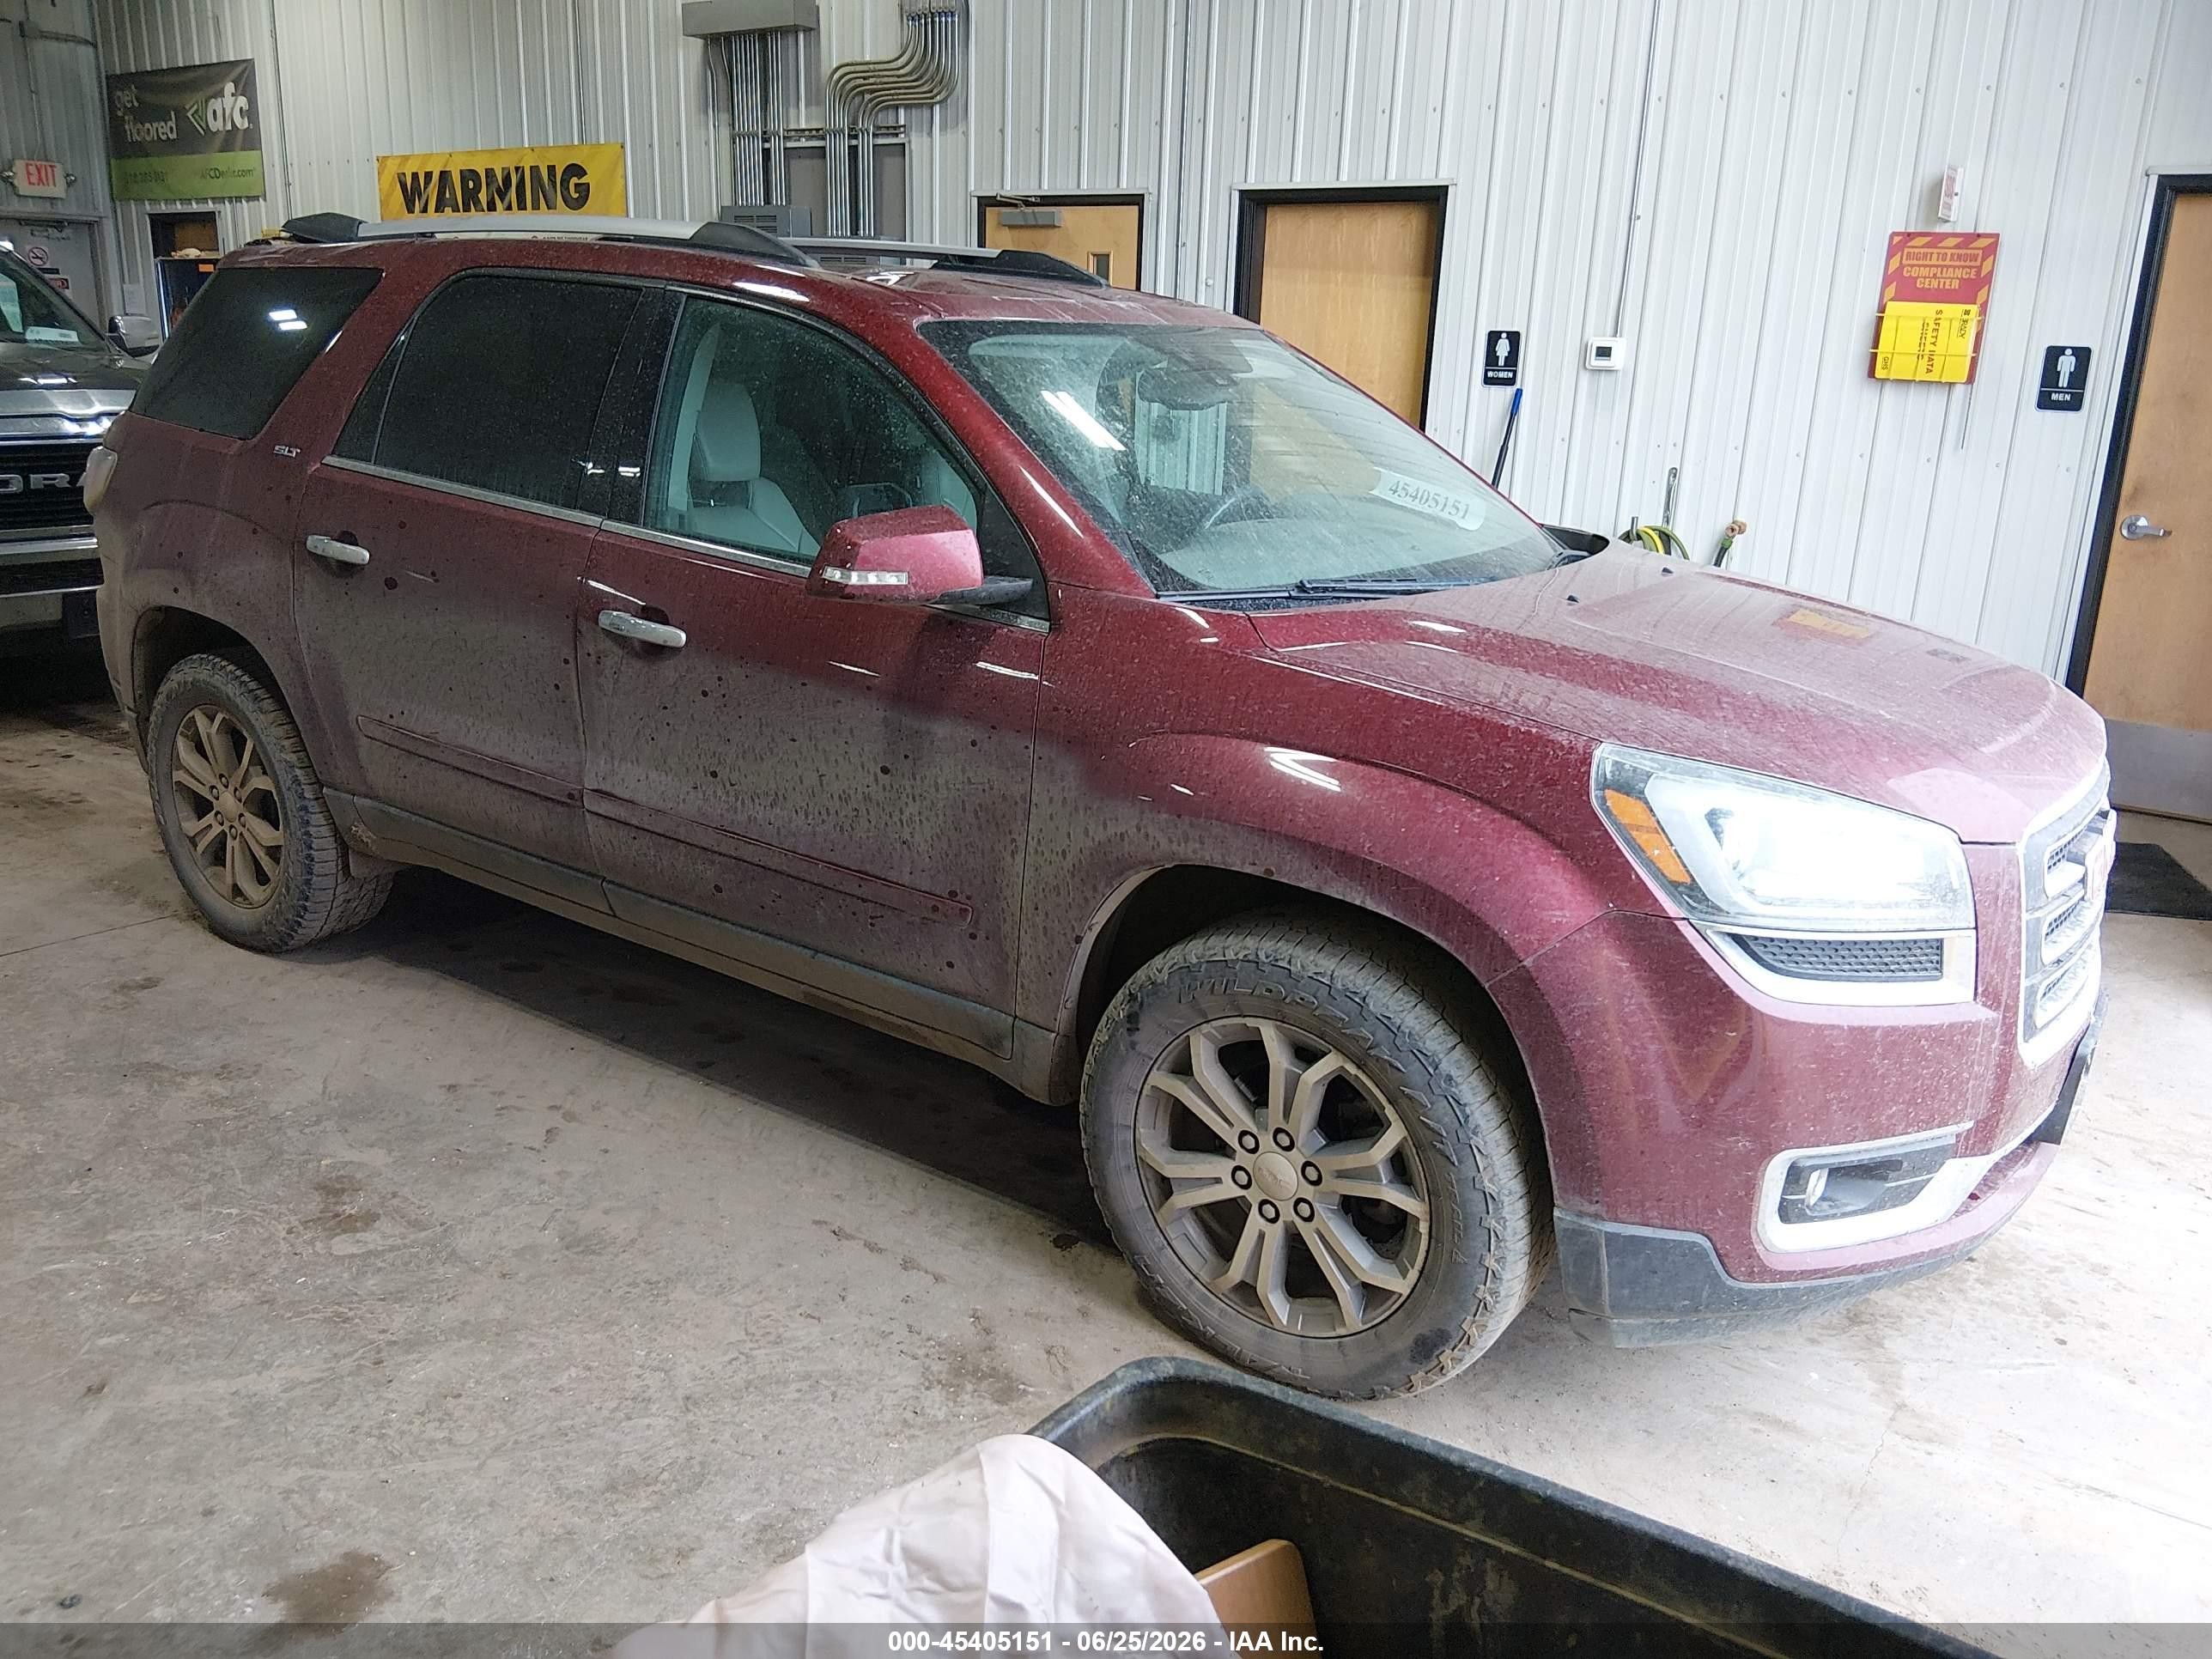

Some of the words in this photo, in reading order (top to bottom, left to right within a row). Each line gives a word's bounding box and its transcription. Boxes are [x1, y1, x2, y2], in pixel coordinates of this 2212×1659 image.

[114, 84, 139, 117] get
[207, 82, 249, 132] afc
[125, 110, 178, 143] floored
[25, 162, 57, 187] EXIT
[397, 162, 591, 215] WARNING
[1905, 251, 1935, 261] RIGHT
[1936, 252, 1948, 262] TO
[1949, 252, 1979, 263] KNOW
[1903, 266, 1978, 279] COMPLIANCE
[1916, 277, 1960, 289] CENTER
[1929, 309, 1943, 348] SAFETY
[1487, 370, 1513, 379] WOMEN
[2051, 392, 2071, 402] MEN
[273, 445, 301, 458] SLT
[1388, 479, 1470, 520] 45405151
